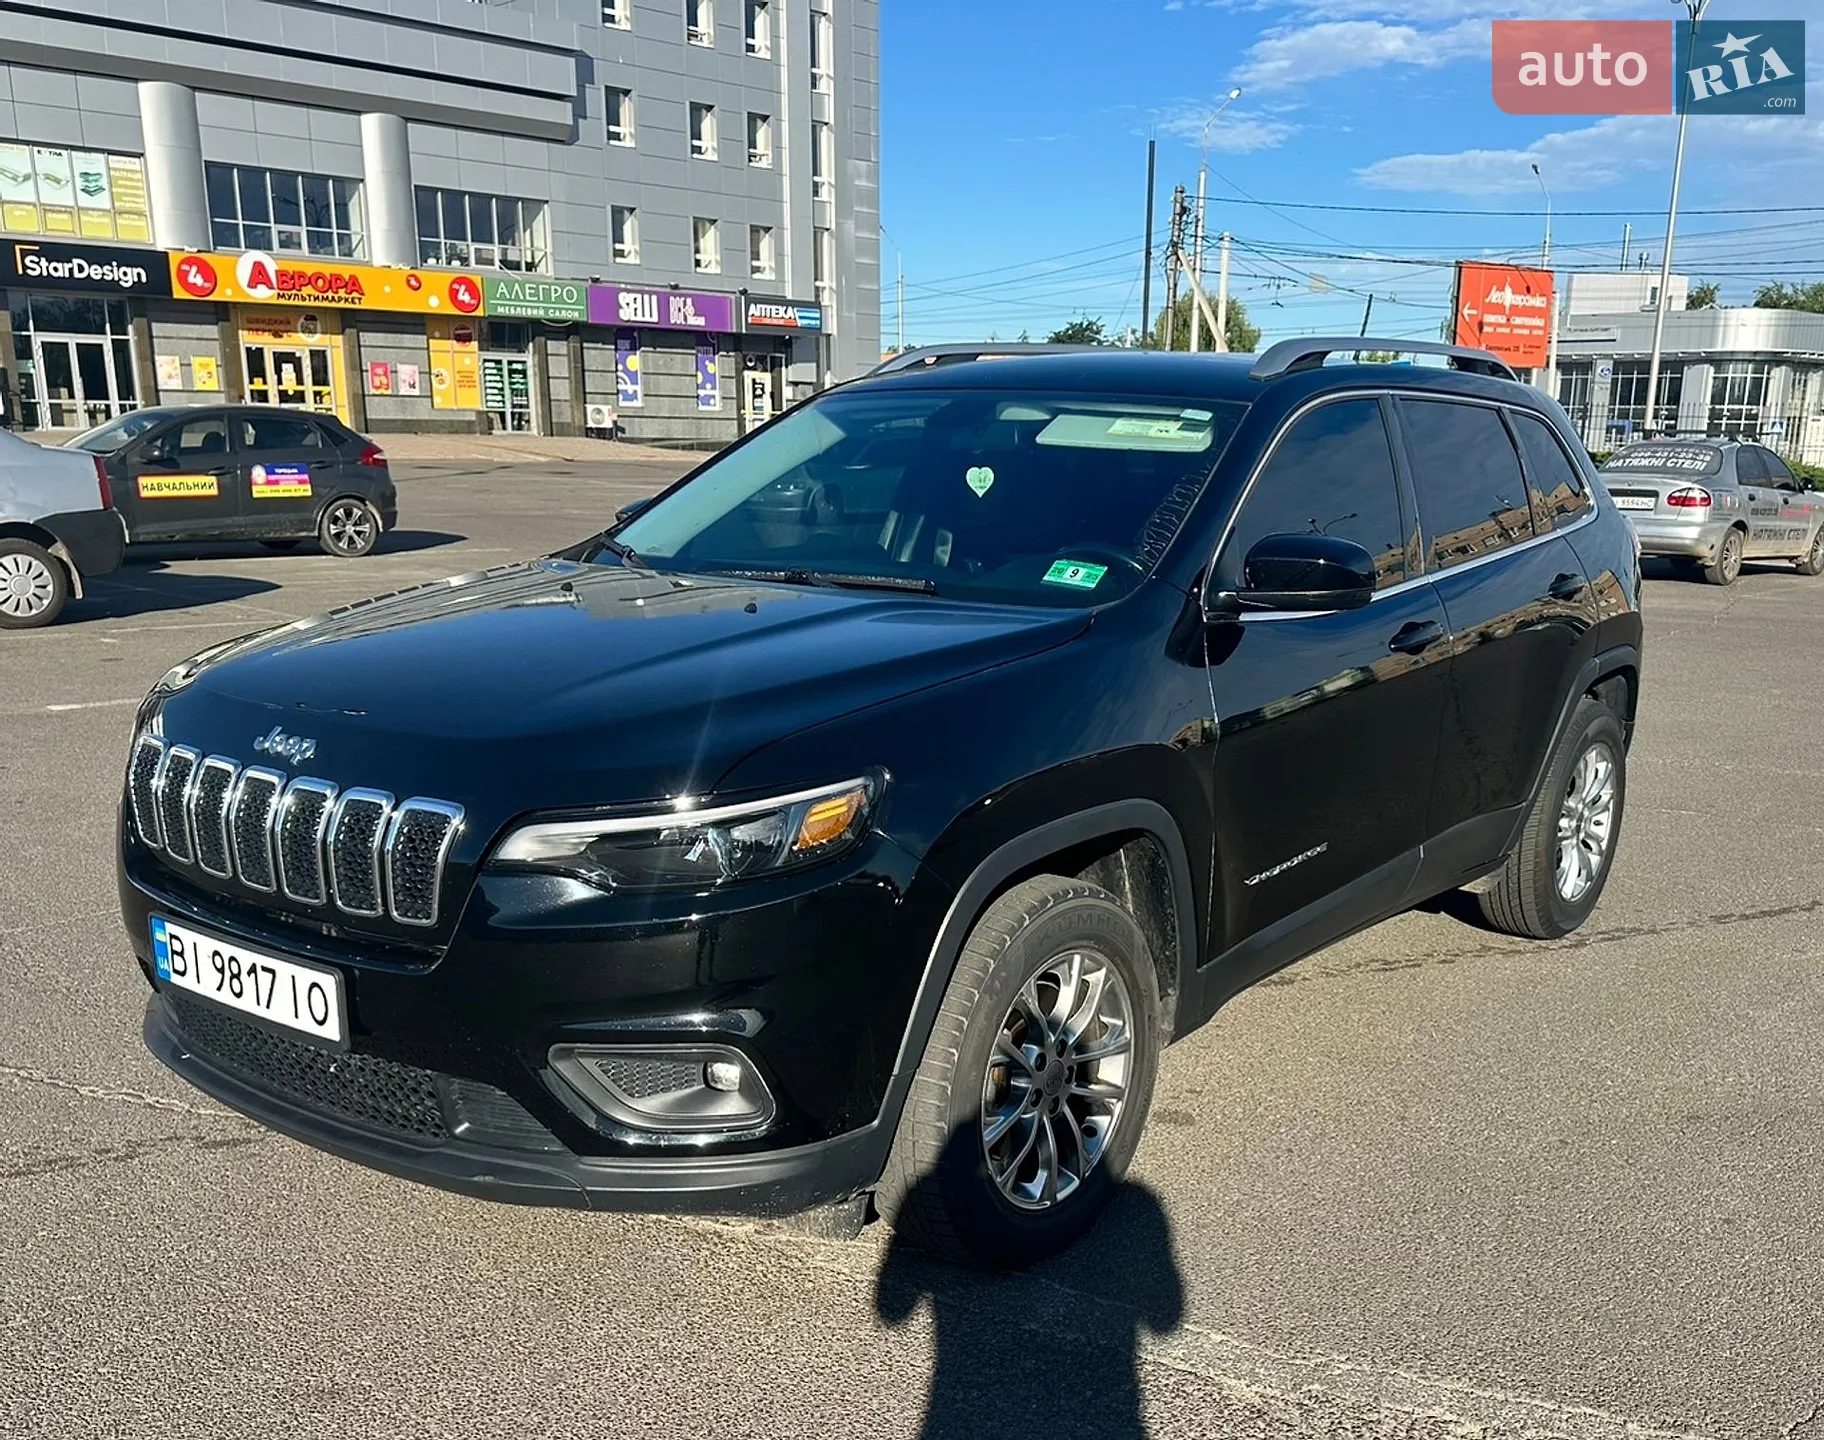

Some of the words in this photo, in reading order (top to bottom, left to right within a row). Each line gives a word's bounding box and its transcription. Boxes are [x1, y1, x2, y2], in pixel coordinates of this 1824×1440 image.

[24, 254, 147, 288] StarDesign
[247, 260, 366, 296] АВРОРА
[276, 291, 363, 305] МУЛЬТИМАРКЕТ
[496, 281, 578, 304] АЛЕГРО
[548, 309, 579, 319] САЛОН
[748, 303, 795, 320] АПТЕКА
[1605, 457, 1666, 469] НАТЯЖНІ
[1666, 458, 1708, 471] СТЕЛІ
[141, 480, 215, 492] НАВЧАЛЬНИЙ
[1069, 568, 1080, 578] 9
[253, 725, 317, 766] Jeep
[158, 957, 170, 971] UA
[169, 933, 201, 984] BI
[212, 950, 277, 1010] 9817
[291, 974, 329, 1027] IO
